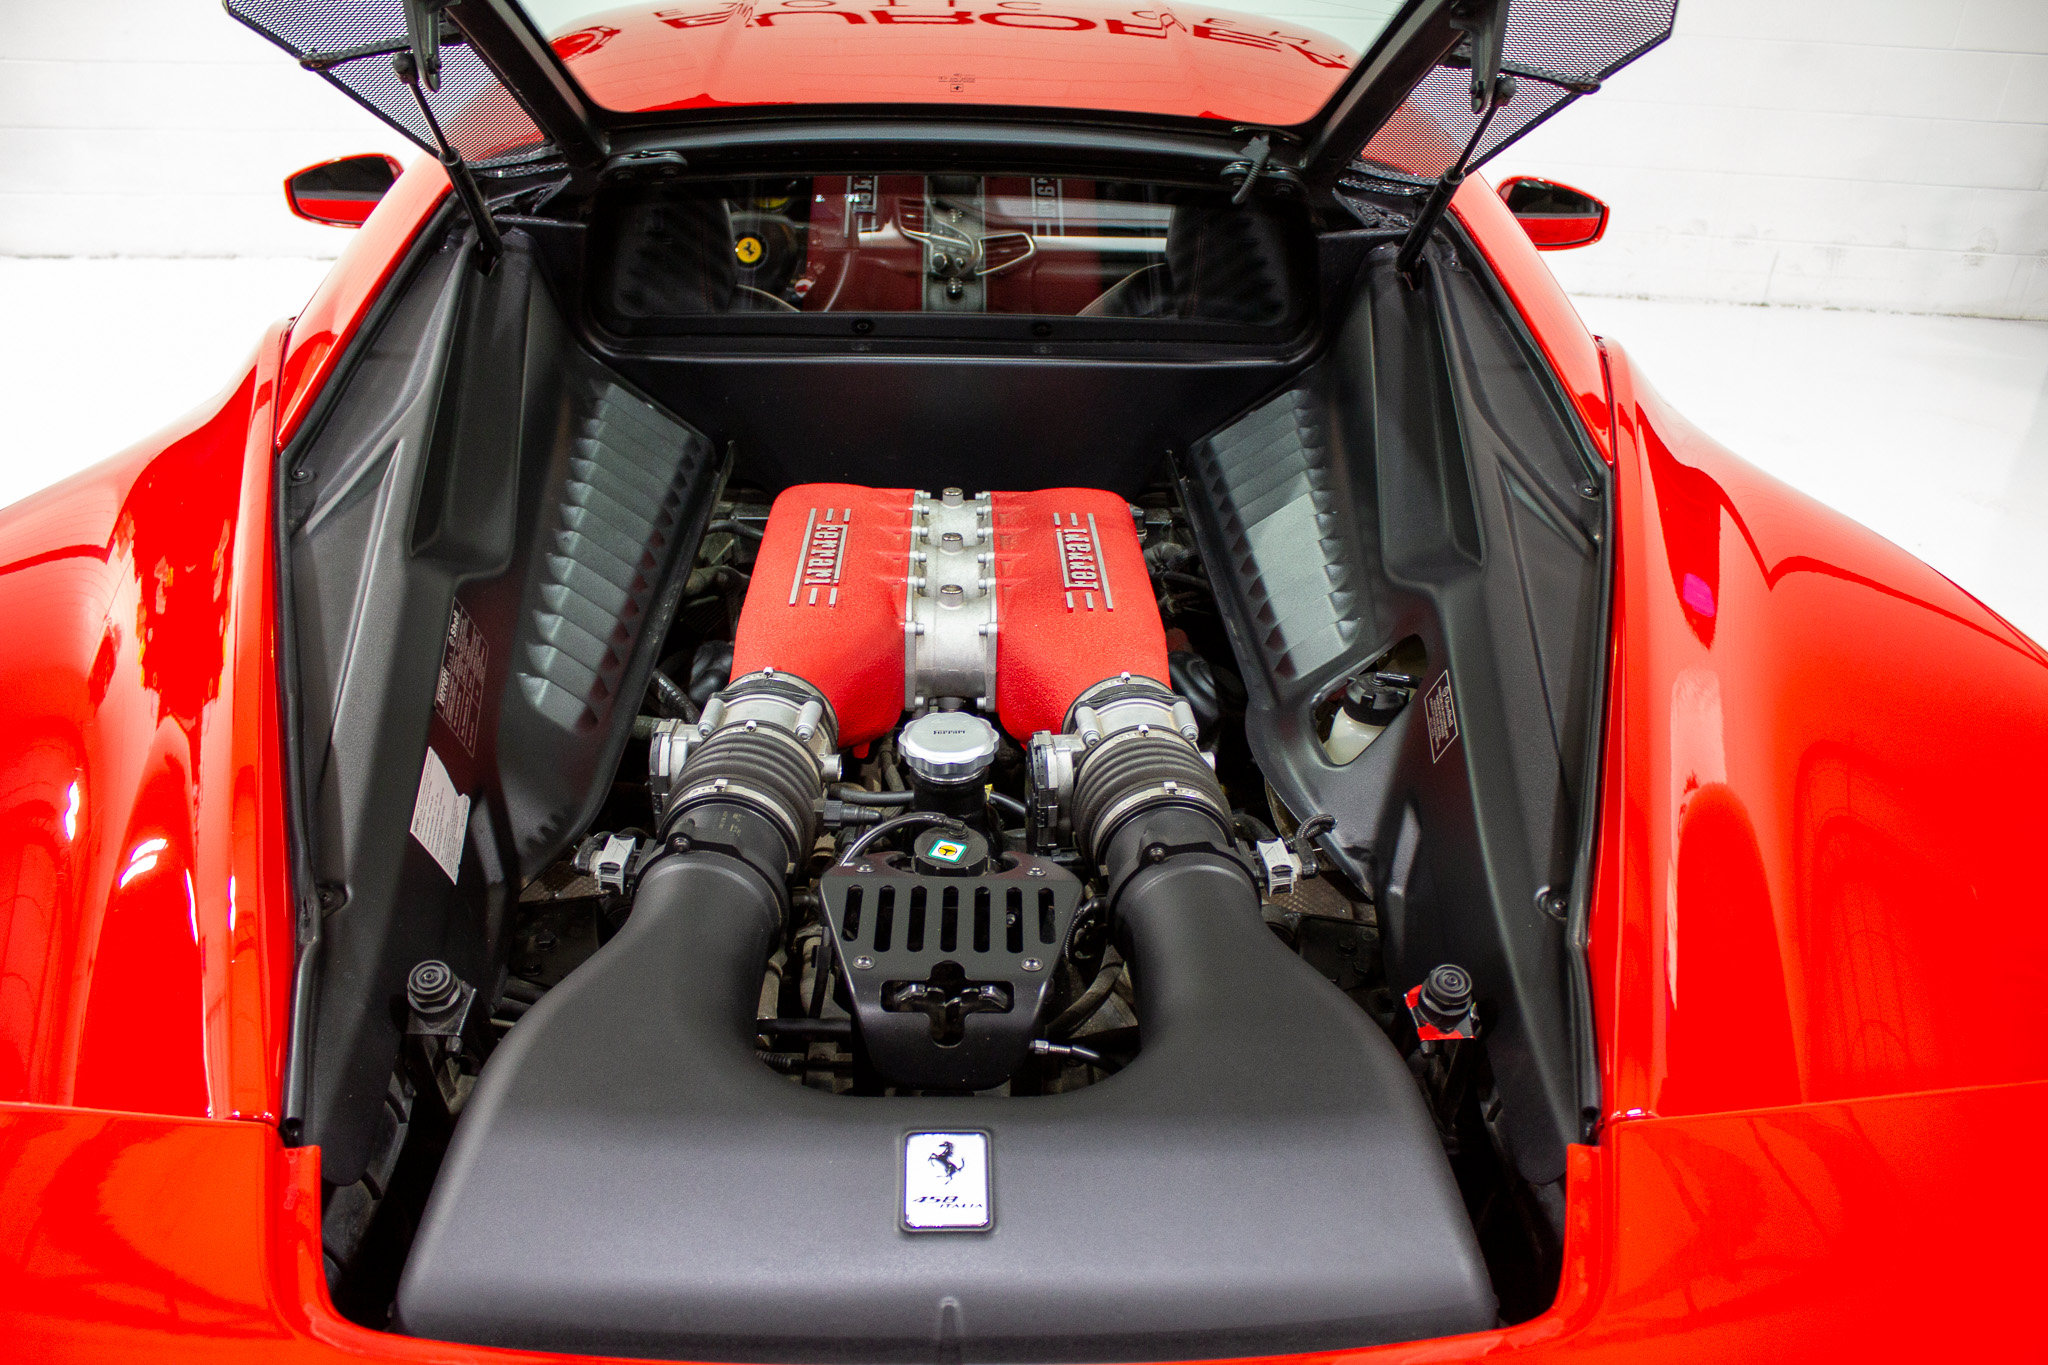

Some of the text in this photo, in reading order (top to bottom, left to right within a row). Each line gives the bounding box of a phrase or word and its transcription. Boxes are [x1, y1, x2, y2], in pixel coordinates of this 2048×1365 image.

[804, 524, 848, 586] Ferrari
[1056, 528, 1098, 591] Ferrari
[450, 610, 459, 638] Shell
